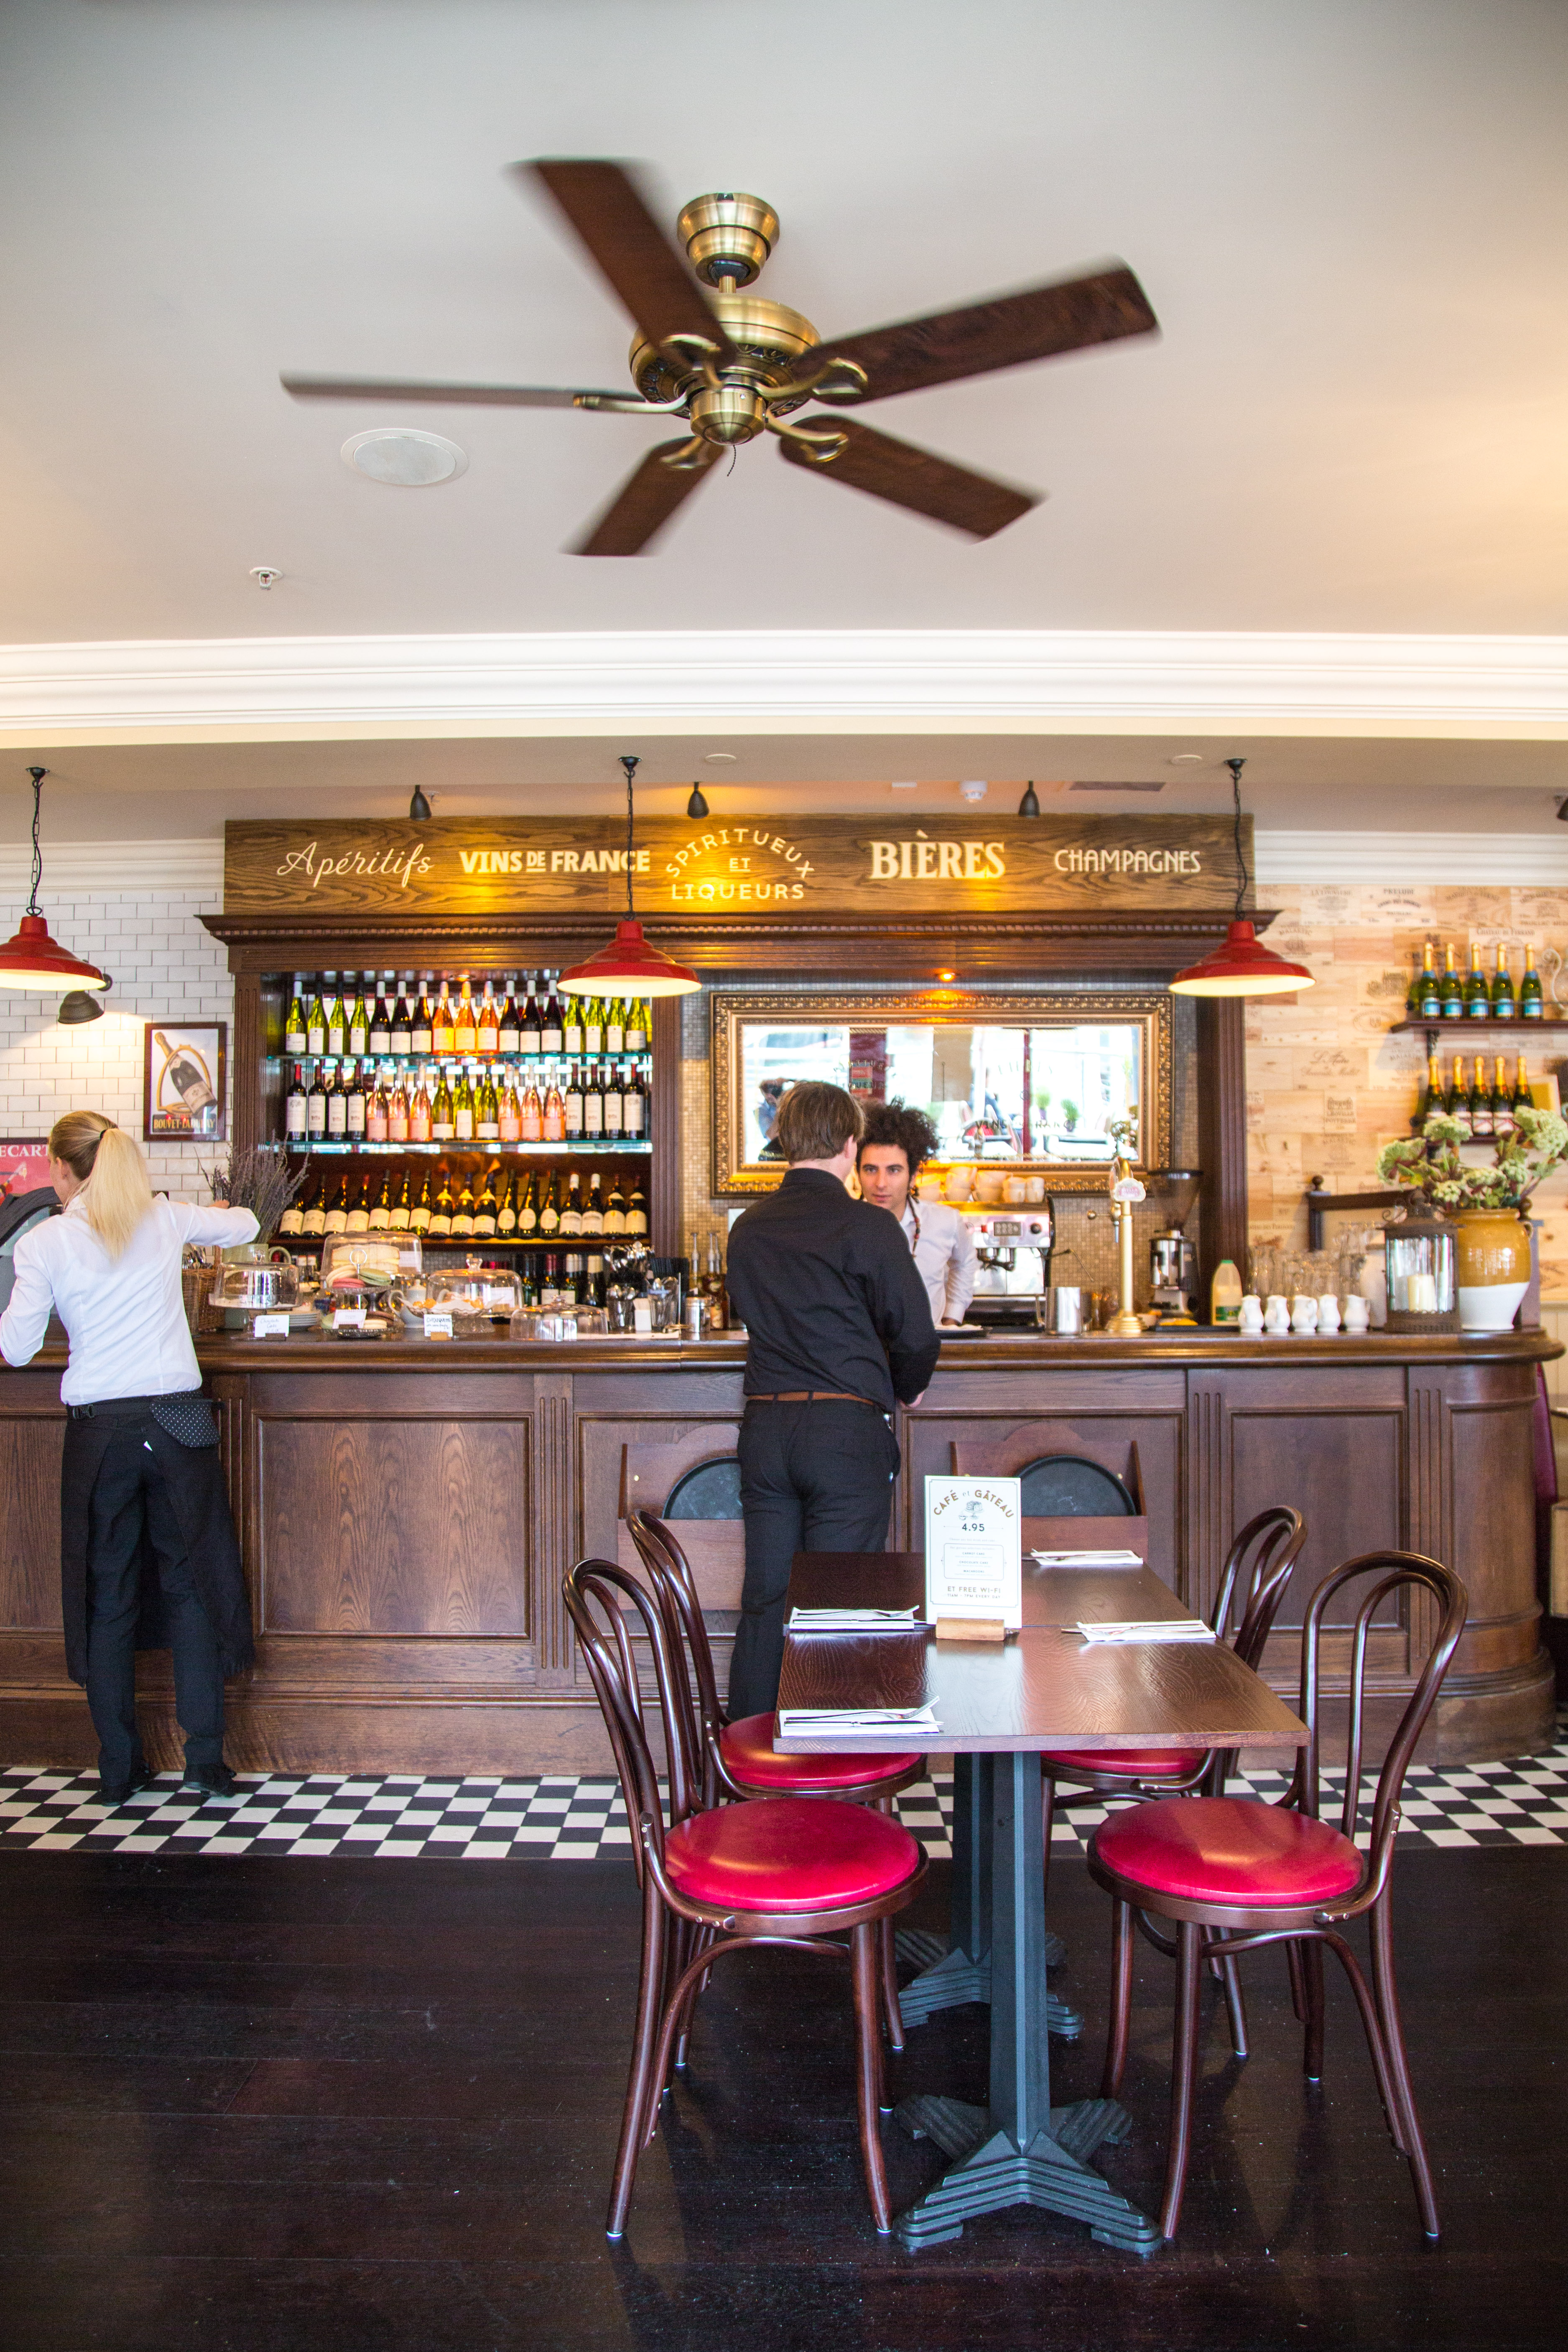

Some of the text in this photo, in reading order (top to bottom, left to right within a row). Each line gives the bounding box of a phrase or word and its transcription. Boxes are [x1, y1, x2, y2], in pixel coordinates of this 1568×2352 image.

[277, 842, 435, 888] Apéritifs
[459, 849, 650, 873] VINS DE FRANCE
[666, 828, 814, 879] SPIRITUEUX
[729, 857, 751, 872] ET
[869, 829, 1006, 879] BIÈRES
[1054, 849, 1201, 873] CHAMPAGNES
[671, 883, 804, 900] LIQUEURS
[934, 1490, 959, 1515] CAFÉ
[974, 1489, 1014, 1518] GÂTEAU
[962, 1523, 985, 1532] 4.95
